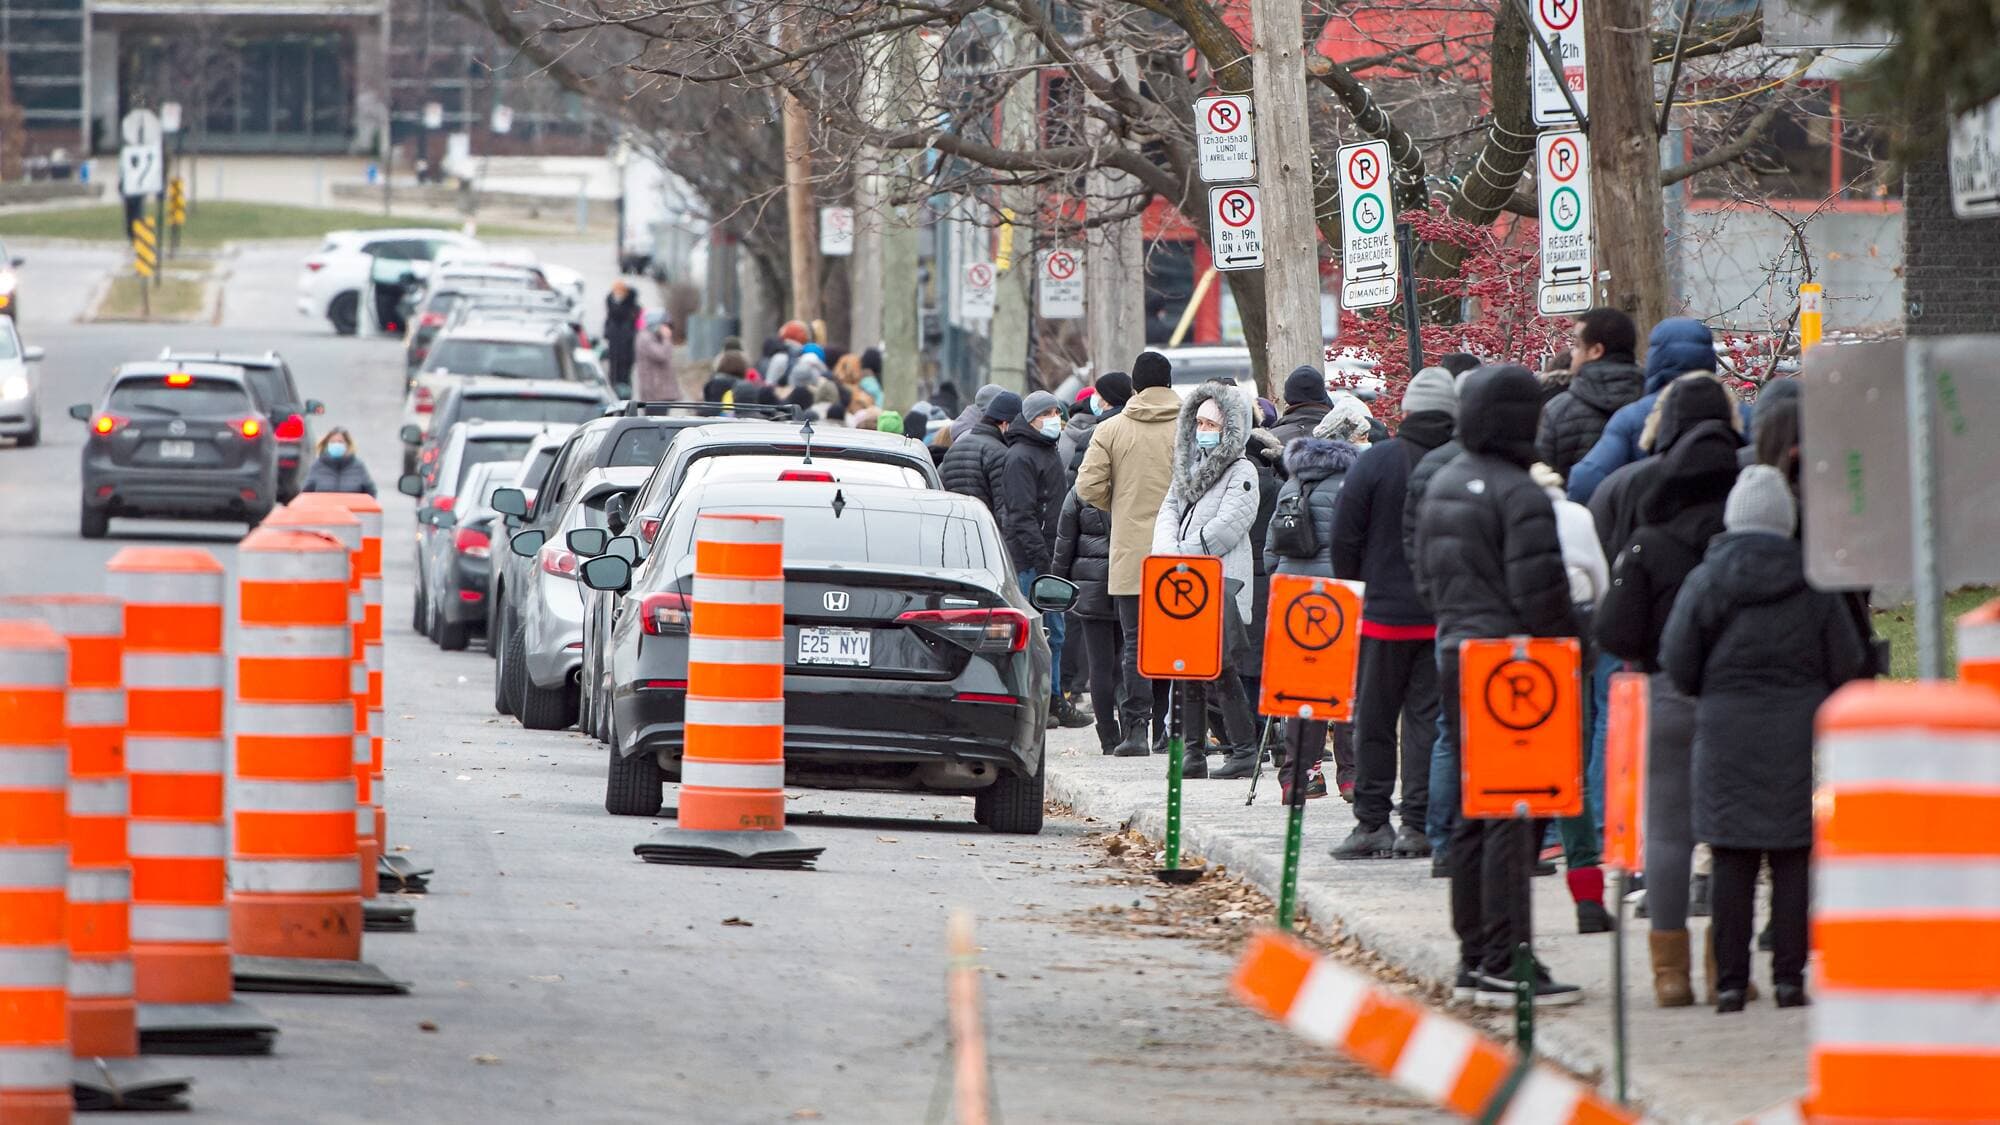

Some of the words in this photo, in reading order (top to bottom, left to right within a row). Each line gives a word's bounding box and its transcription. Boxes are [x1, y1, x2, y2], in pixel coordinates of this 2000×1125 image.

[1568, 75, 1582, 91] 62
[1216, 144, 1237, 153] LUNDI
[1210, 153, 1226, 161] AVRIL
[1221, 230, 1234, 241] 8h
[1241, 229, 1256, 240] 19h
[1351, 232, 1390, 252] RÉSERVÉ
[1219, 243, 1233, 254] LUN
[1245, 241, 1260, 252] VEN
[1349, 285, 1390, 300] DIMANCHE
[1546, 291, 1587, 305] DIMANCHE
[801, 634, 830, 654] E25
[840, 636, 869, 656] NYV
